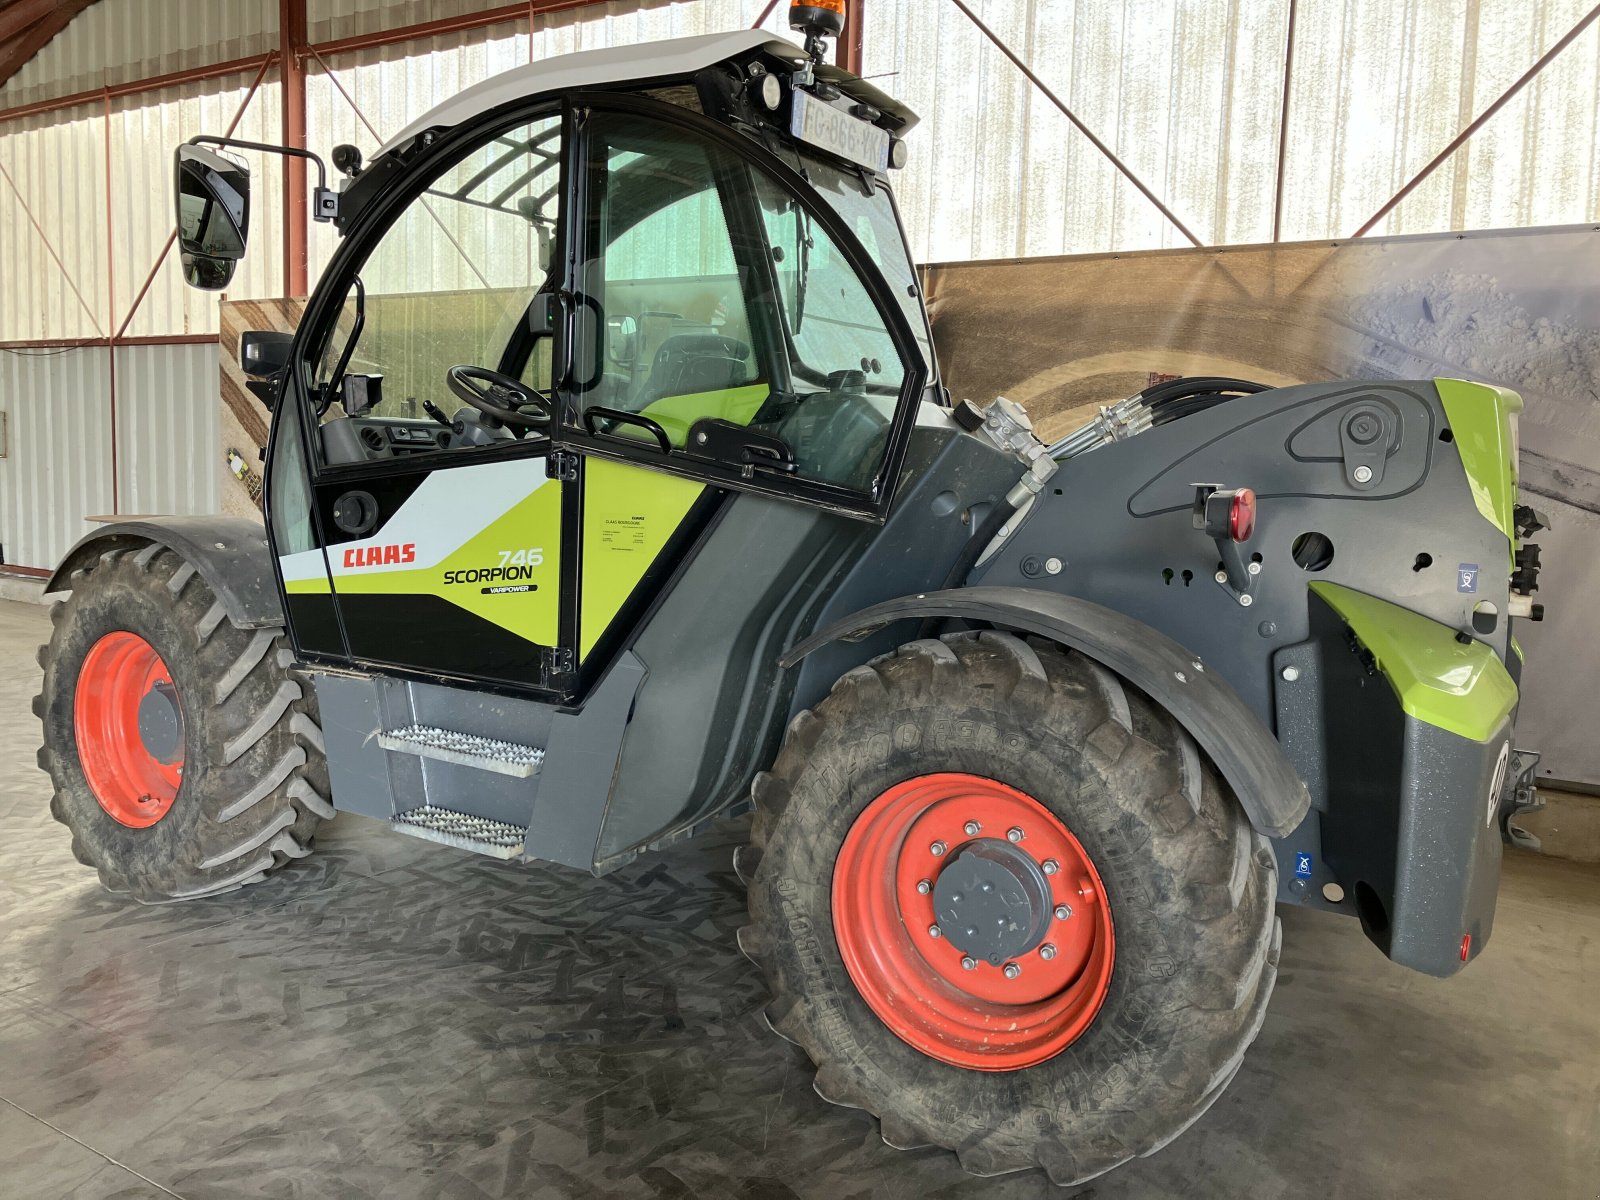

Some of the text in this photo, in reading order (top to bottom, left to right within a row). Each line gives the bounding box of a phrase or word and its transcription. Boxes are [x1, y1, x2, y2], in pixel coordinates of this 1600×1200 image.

[343, 543, 416, 568] CLAAS
[498, 547, 544, 568] 746
[443, 565, 533, 585] SCORPION
[490, 585, 530, 594] VARIPOWER
